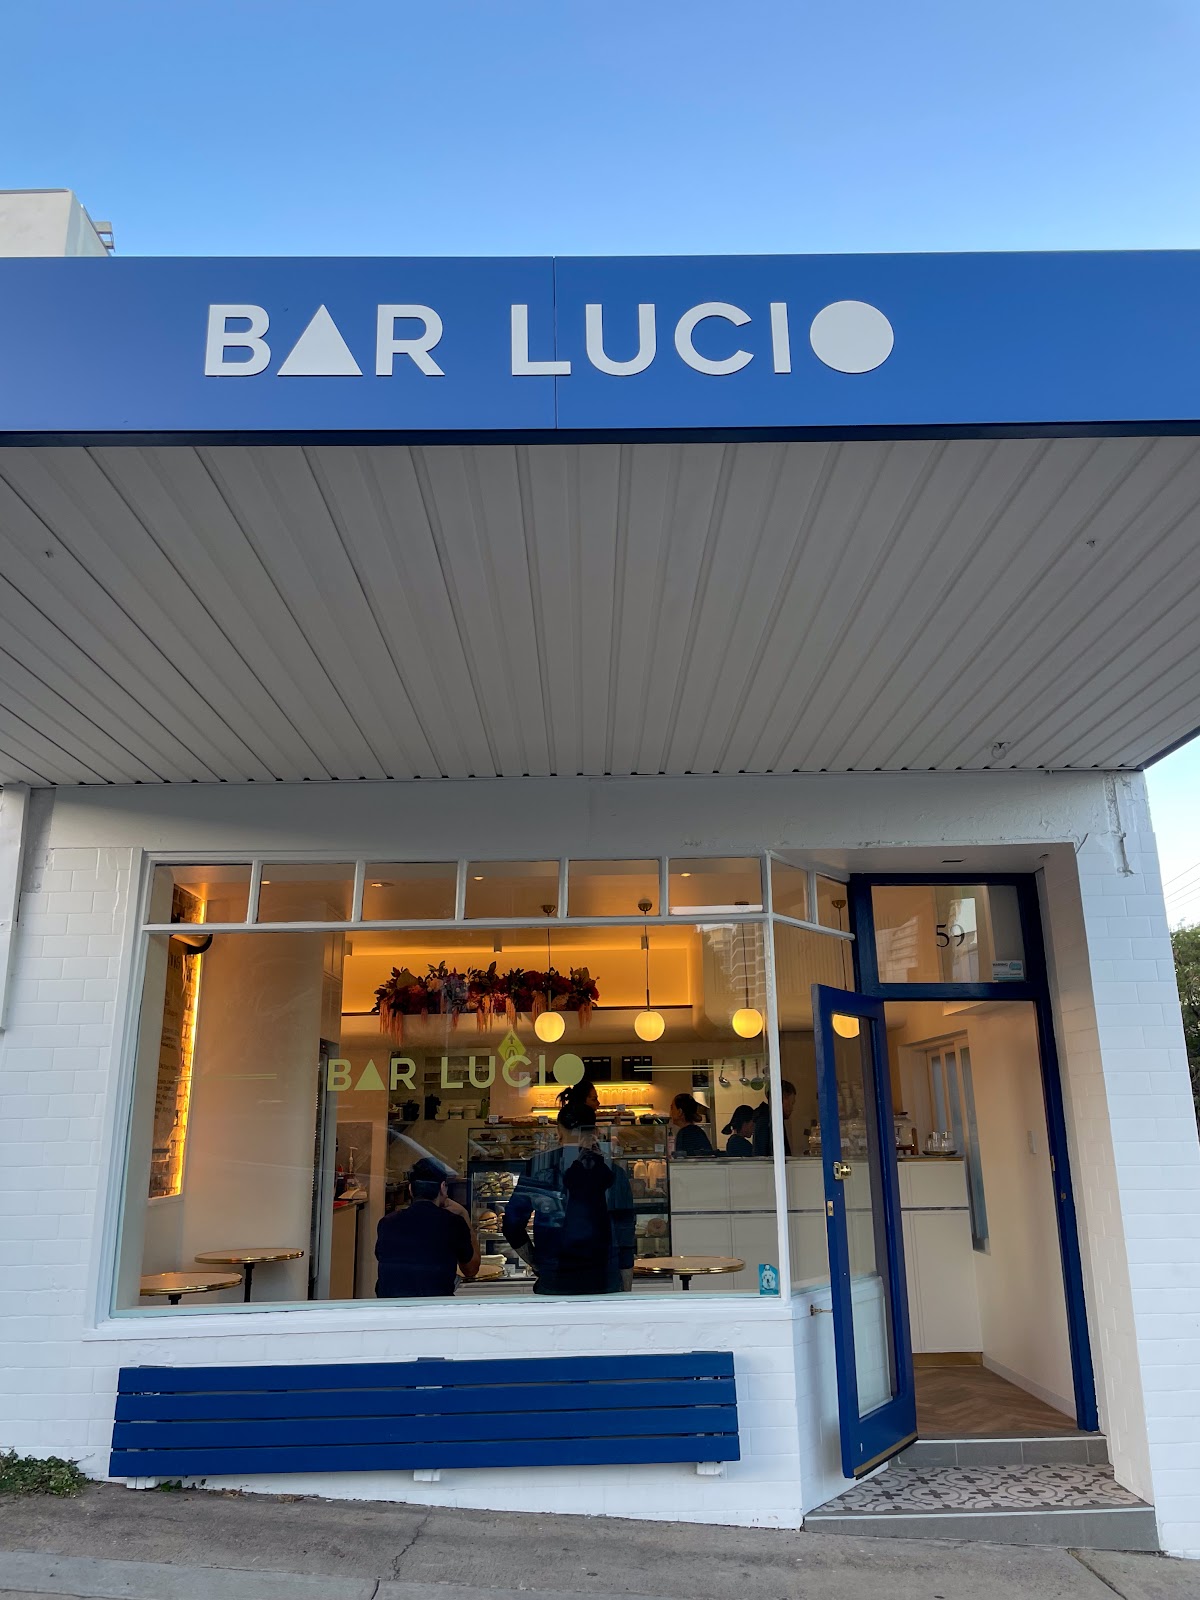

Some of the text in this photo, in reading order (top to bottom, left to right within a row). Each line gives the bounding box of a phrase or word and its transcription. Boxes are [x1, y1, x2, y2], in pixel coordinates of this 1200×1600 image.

[204, 300, 895, 377] BAR LUCIO
[936, 923, 965, 948] 59
[326, 1053, 585, 1092] BAR LUCIO
